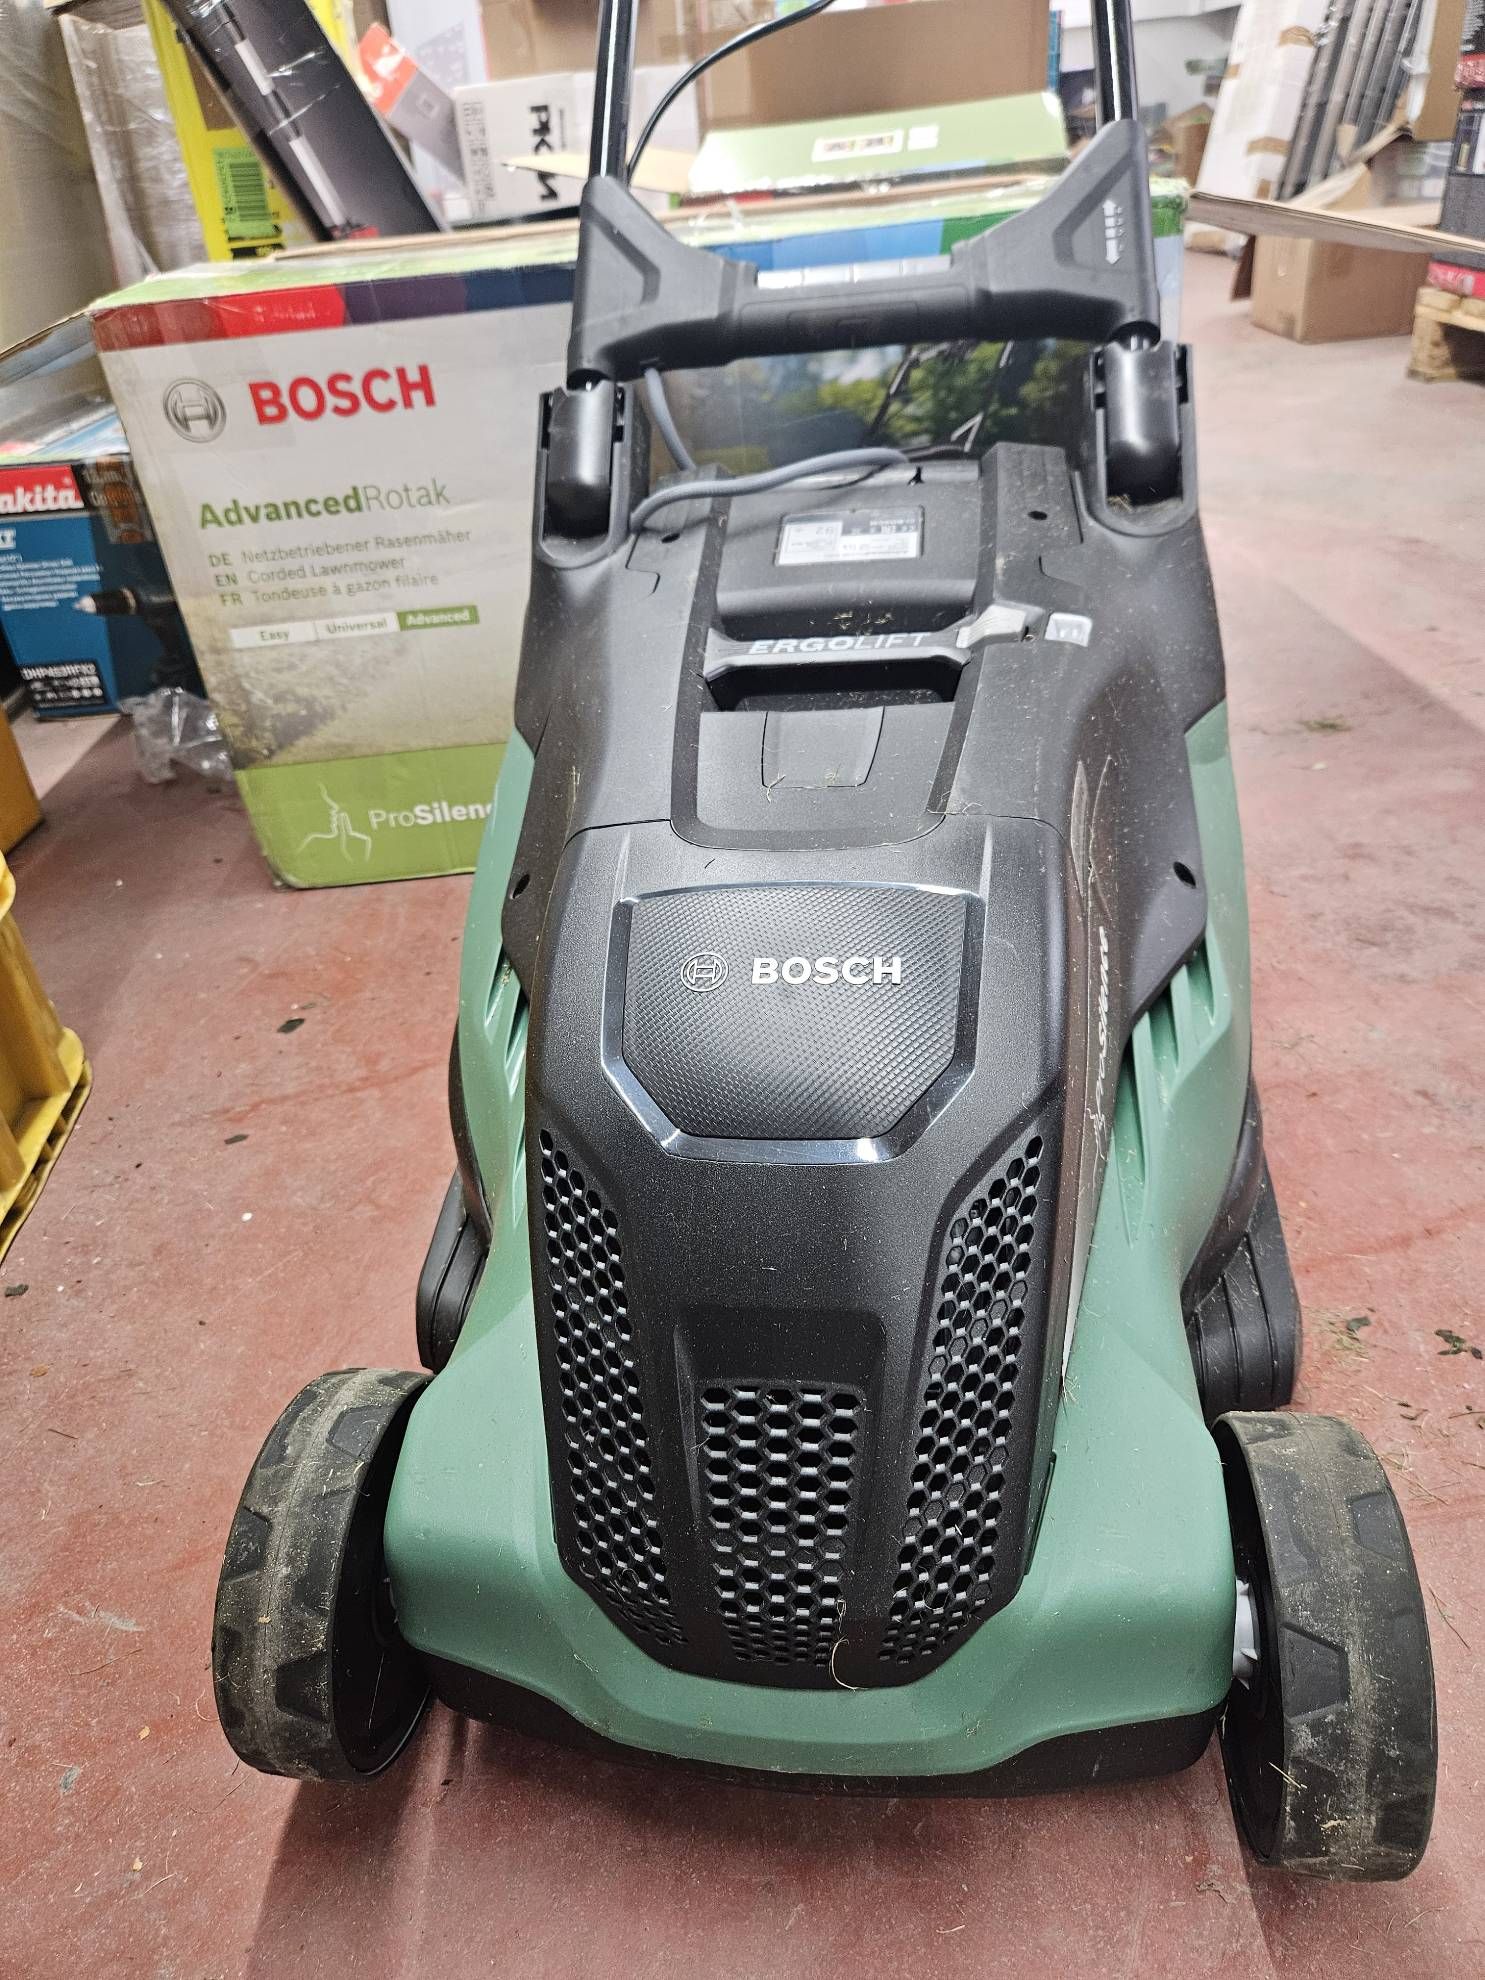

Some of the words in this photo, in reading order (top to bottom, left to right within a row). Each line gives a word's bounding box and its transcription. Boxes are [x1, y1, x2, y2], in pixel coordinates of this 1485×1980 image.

[249, 364, 436, 426] BOSCH
[0, 484, 84, 515] akita
[200, 478, 450, 529] AdvancedRotak
[208, 552, 233, 568] DE
[241, 540, 369, 564] Netzbetriebener
[375, 529, 471, 550] Rasenmäher
[215, 573, 239, 588] EN
[248, 565, 306, 584] Corded
[311, 557, 405, 578] Lawnmower
[219, 592, 243, 607] FR
[251, 585, 327, 603] Tondeuse
[332, 581, 342, 596] à
[346, 578, 391, 597] gazon
[395, 573, 439, 588] filaire
[260, 626, 290, 642] Easy
[326, 618, 387, 635] Universal
[406, 609, 471, 627] Advanced
[749, 632, 931, 655] ERGOLIFT
[751, 956, 902, 986] BOSCH
